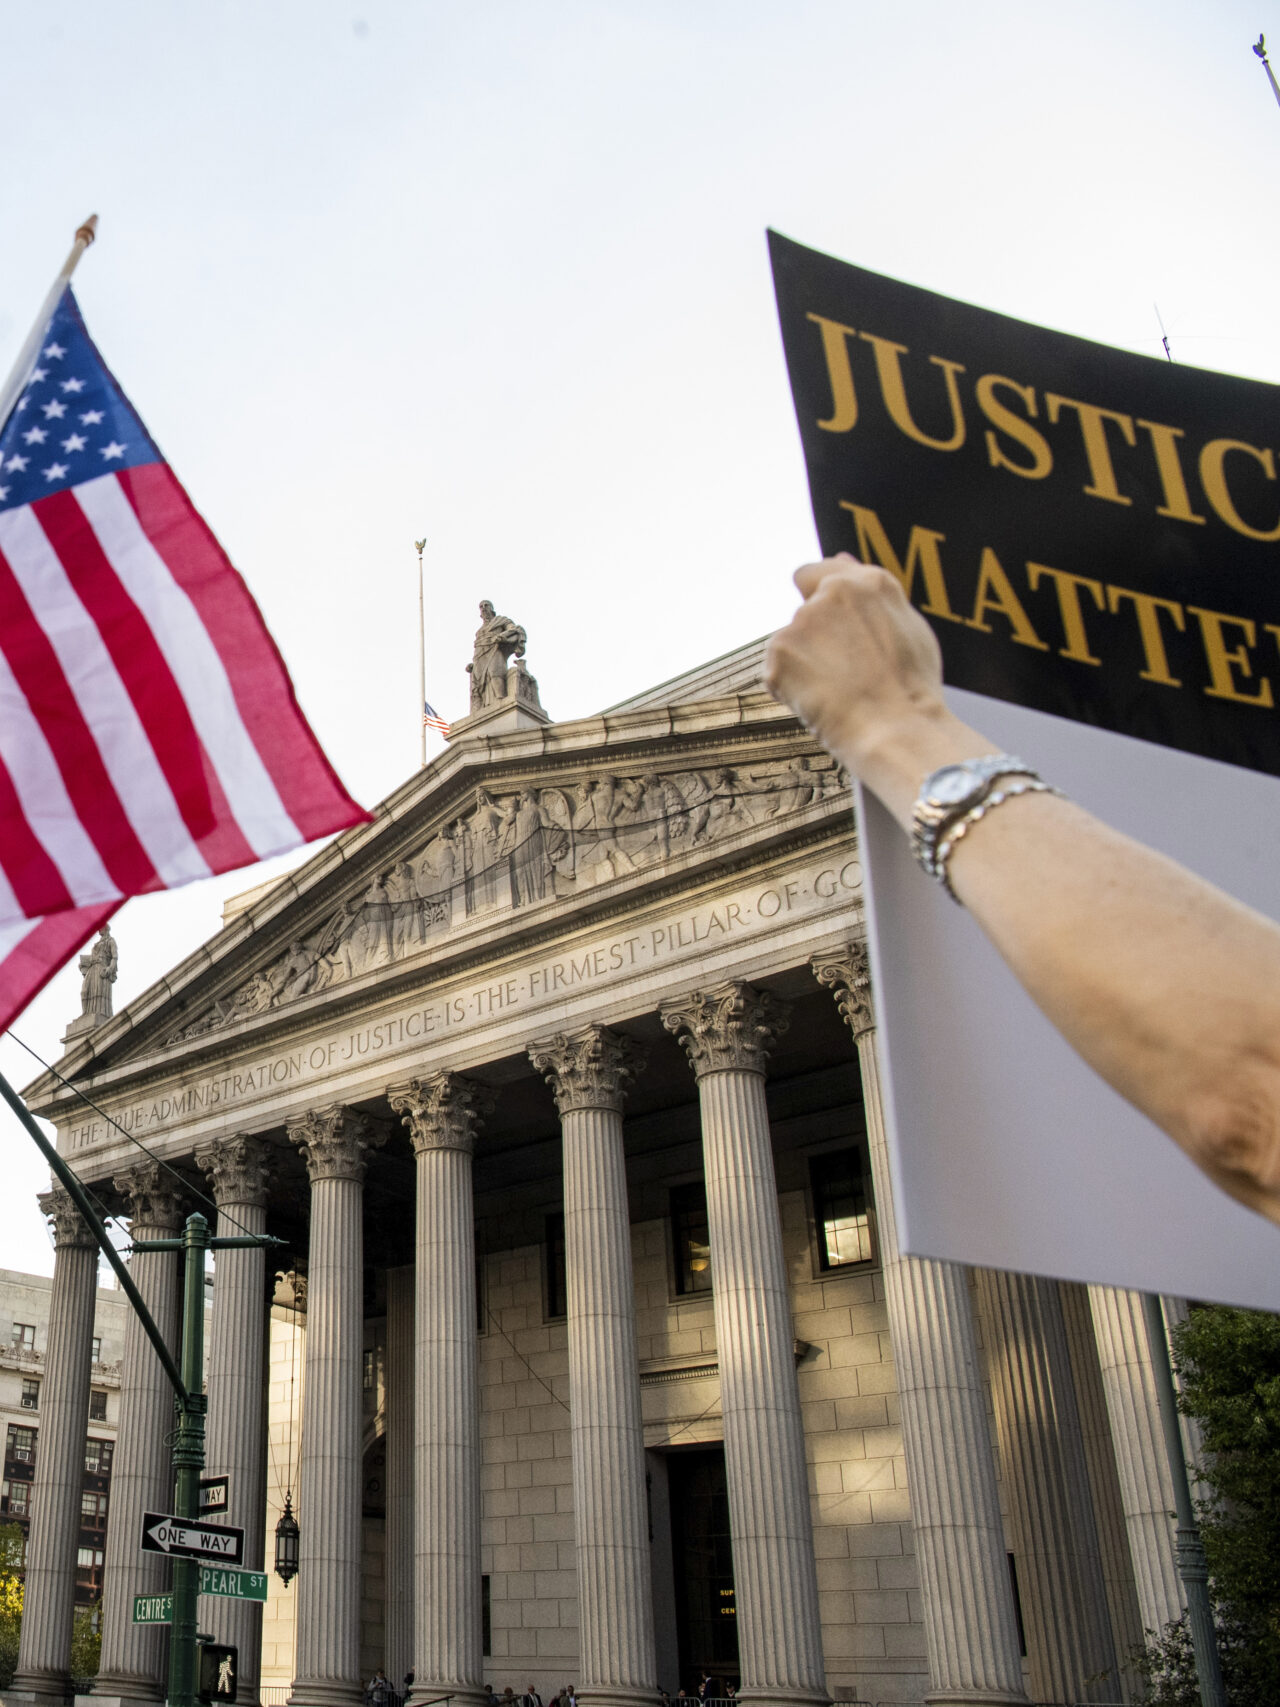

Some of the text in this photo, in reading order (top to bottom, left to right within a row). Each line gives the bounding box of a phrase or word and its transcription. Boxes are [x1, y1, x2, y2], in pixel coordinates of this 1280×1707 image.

[839, 499, 1280, 709] MATTE
[72, 1122, 99, 1149] THE
[105, 1107, 143, 1138] TRUE
[148, 1053, 302, 1125] ADMINISTRATION
[309, 1041, 337, 1070] OF
[343, 1008, 435, 1060] JUSTICE
[445, 997, 466, 1026] IS
[472, 978, 519, 1016] THE
[528, 936, 640, 997] FIRMEST
[651, 902, 748, 956] PILLAR
[757, 881, 799, 917] OF
[205, 1487, 222, 1504] WAY
[158, 1527, 231, 1551] ONE WAY
[202, 1569, 264, 1596] PEARL ST
[136, 1597, 173, 1620] CENTRE S
